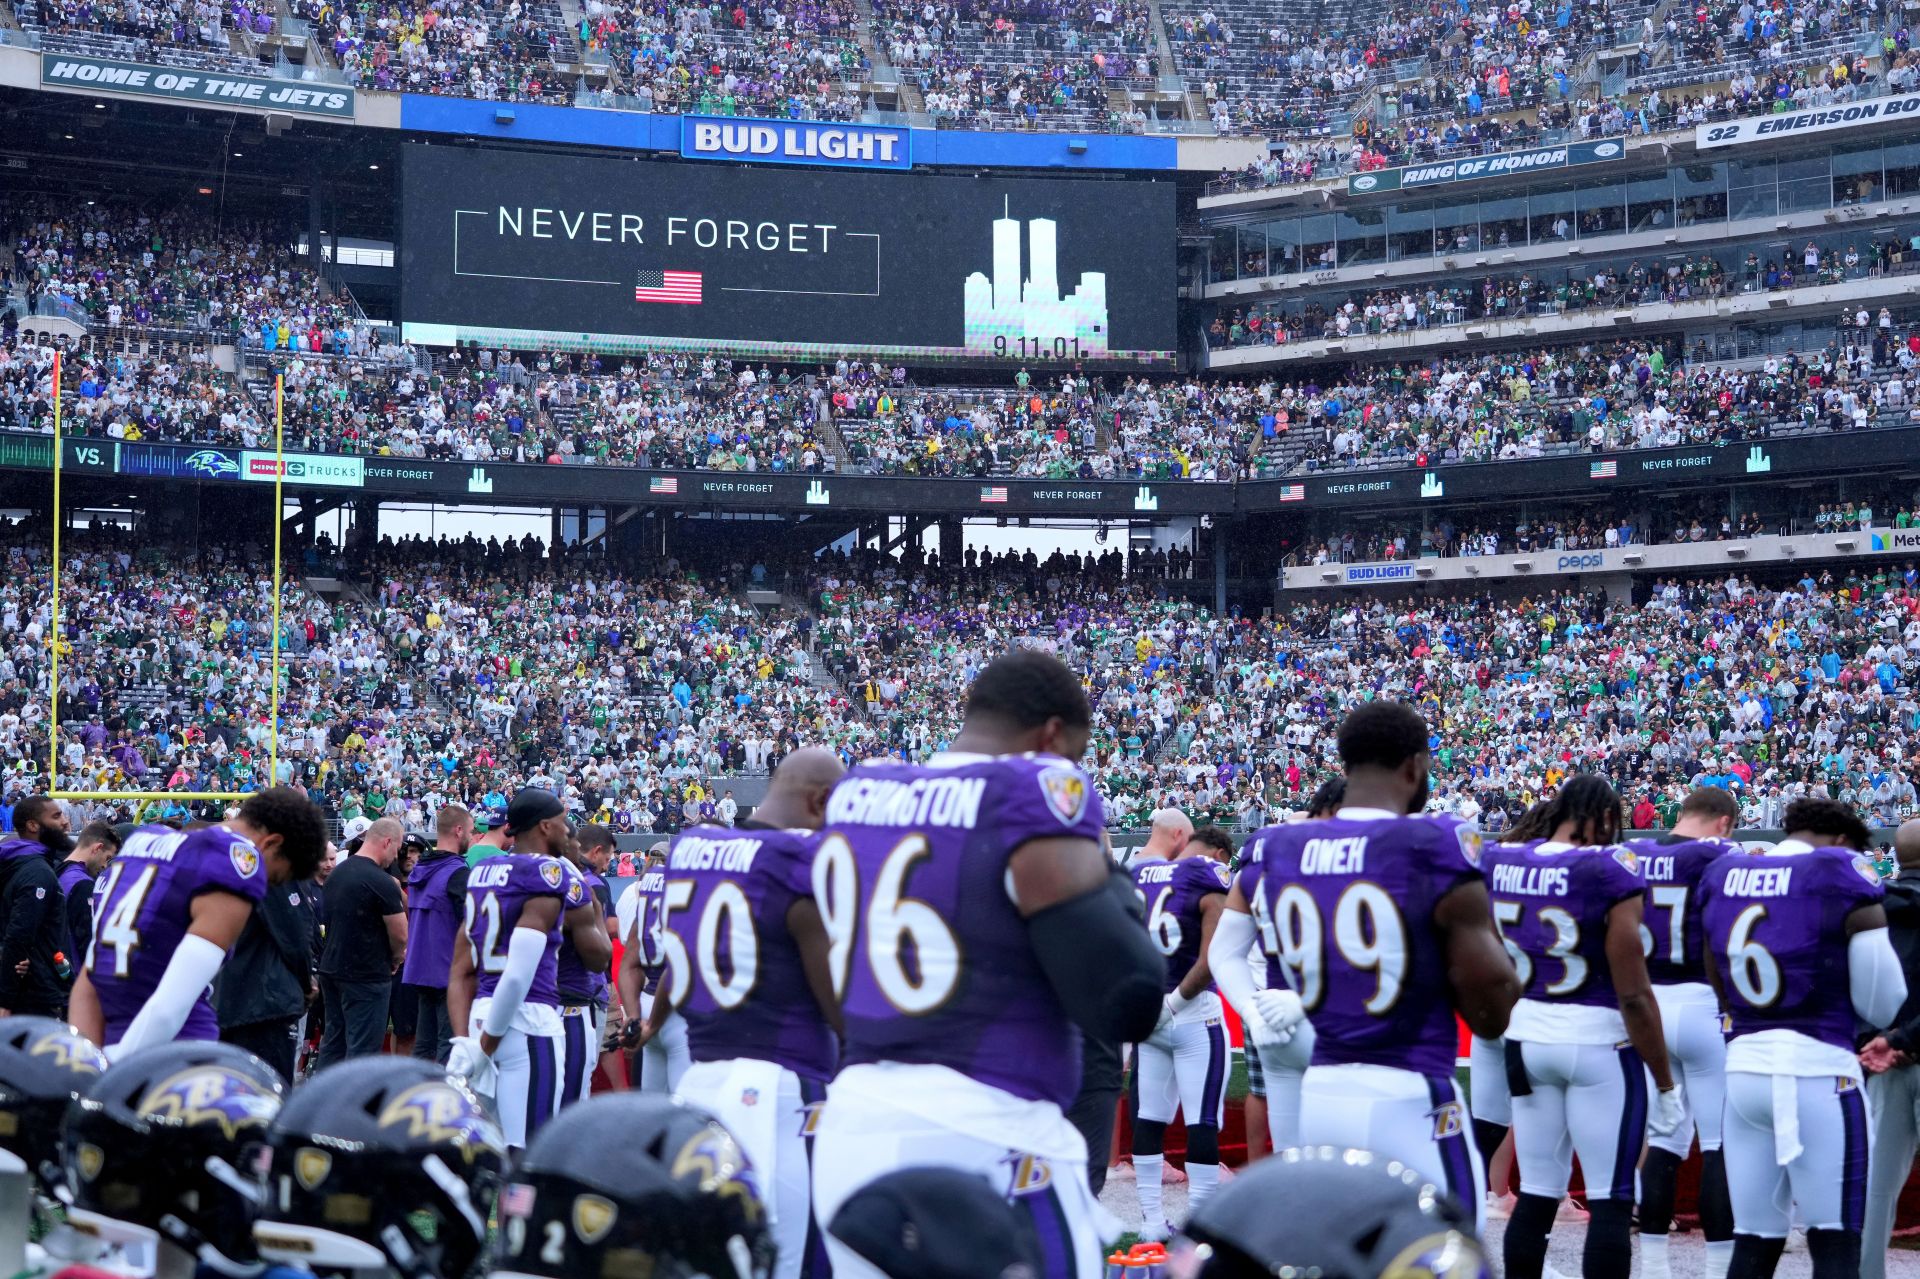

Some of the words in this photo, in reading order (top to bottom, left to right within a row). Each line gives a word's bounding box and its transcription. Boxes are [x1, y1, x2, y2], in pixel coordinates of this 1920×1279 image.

[50, 62, 150, 87] HOME
[153, 74, 200, 91] OF
[204, 79, 267, 100] THE
[269, 87, 347, 109] JETS
[1707, 125, 1740, 142] 32
[1756, 104, 1879, 135] EMERSON
[695, 123, 778, 154] BUD
[784, 128, 899, 161] LIGHT
[1402, 165, 1455, 184] RING
[1458, 160, 1488, 176] OF
[1488, 150, 1567, 172] HONOR
[499, 206, 644, 244] NEVER
[667, 216, 838, 253] FORGET
[75, 446, 105, 466] VS.
[309, 465, 355, 477] TRUCKS
[1642, 458, 1673, 470] NEVER
[1675, 456, 1712, 467] FORGET
[361, 468, 393, 478] NEVER
[396, 469, 434, 480] FORGET
[703, 482, 734, 492] NEVER
[737, 483, 773, 493] FORGET
[1327, 484, 1355, 494] NEVER
[1357, 481, 1391, 492] FORGET
[1033, 491, 1063, 499] NEVER
[1066, 491, 1102, 500] FORGET
[1349, 568, 1375, 580] BUD
[1376, 565, 1412, 577] LIGHT
[1558, 552, 1602, 570] pepsi
[670, 836, 763, 873] HOUSTON
[1300, 835, 1369, 875] OWEH
[1138, 862, 1178, 885] STONE
[1492, 863, 1570, 896] PHILLIPS
[1723, 867, 1793, 897] QUEEN
[85, 861, 157, 977] 14
[811, 832, 960, 1016] 96
[661, 879, 759, 1010] 50
[1275, 881, 1406, 1015] 99
[1493, 901, 1589, 996] 53
[1727, 902, 1782, 1008] 6
